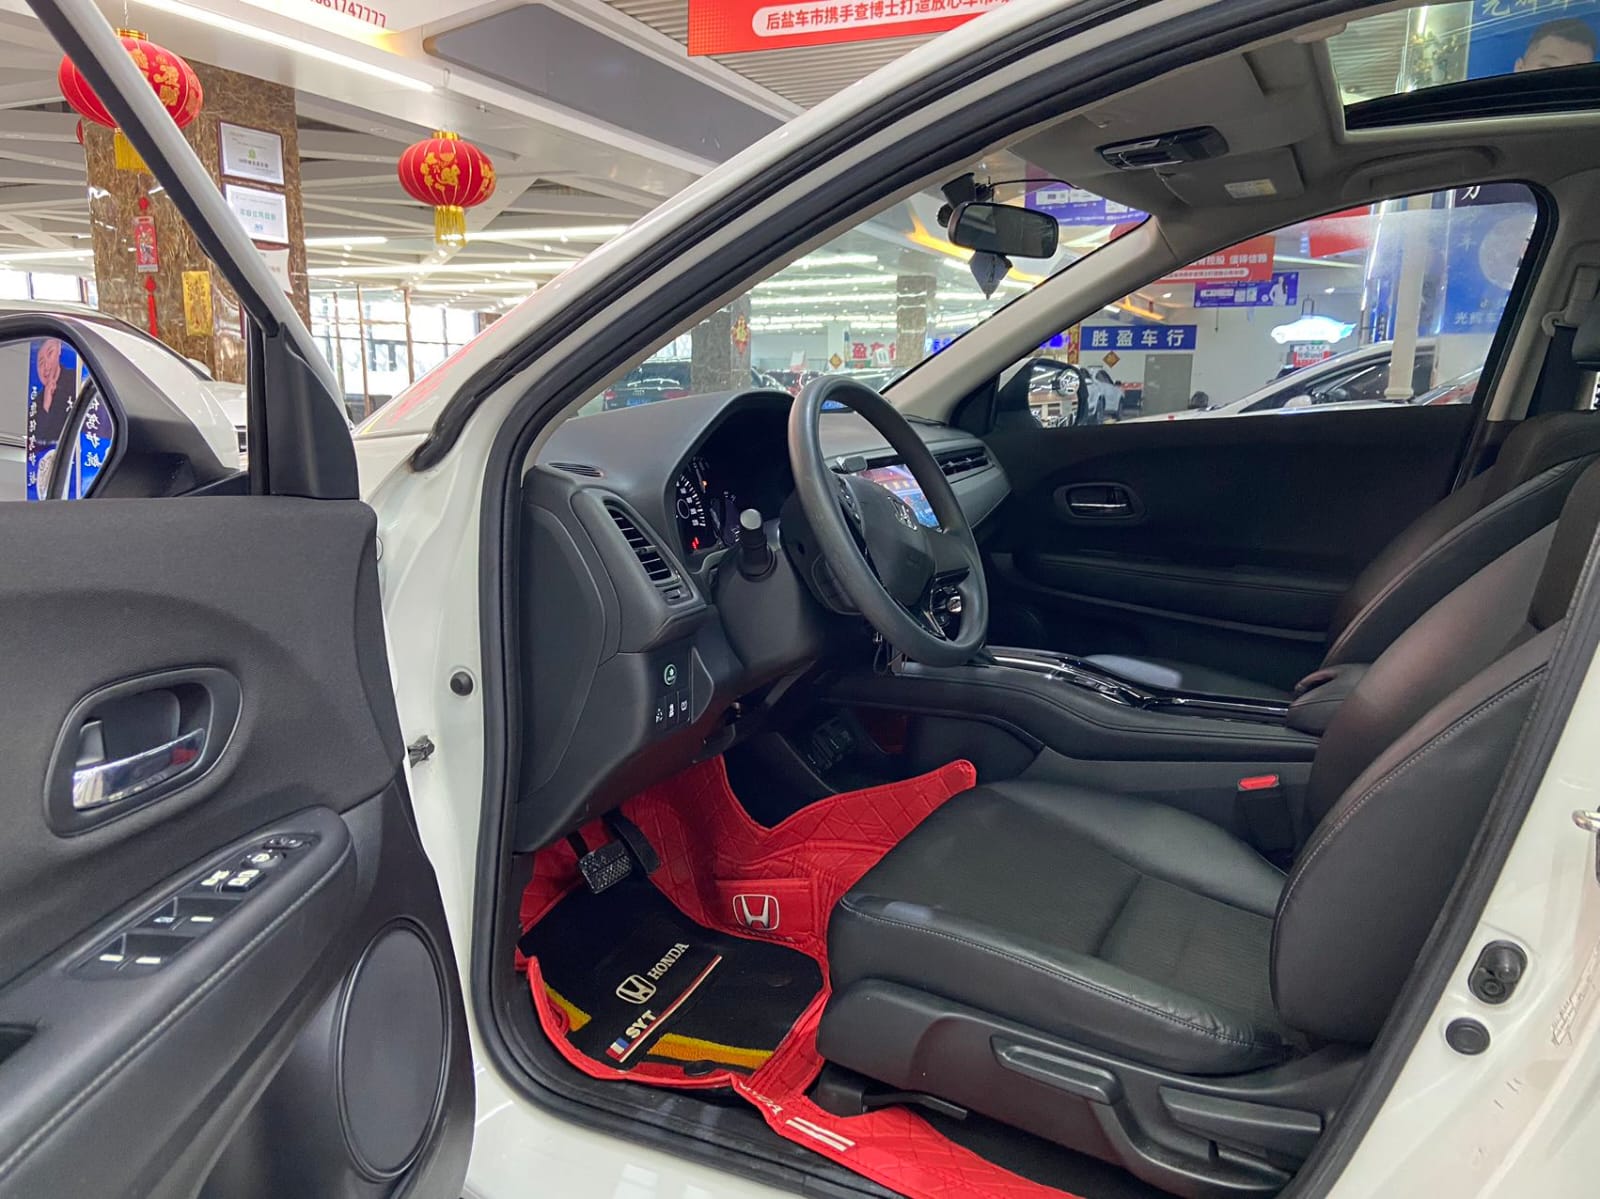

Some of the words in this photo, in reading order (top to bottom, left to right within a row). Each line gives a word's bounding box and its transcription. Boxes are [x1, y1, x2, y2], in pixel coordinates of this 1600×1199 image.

[1091, 329, 1185, 347] 胜盈车行
[647, 942, 690, 981] HONDA
[625, 1009, 657, 1040] SYT
